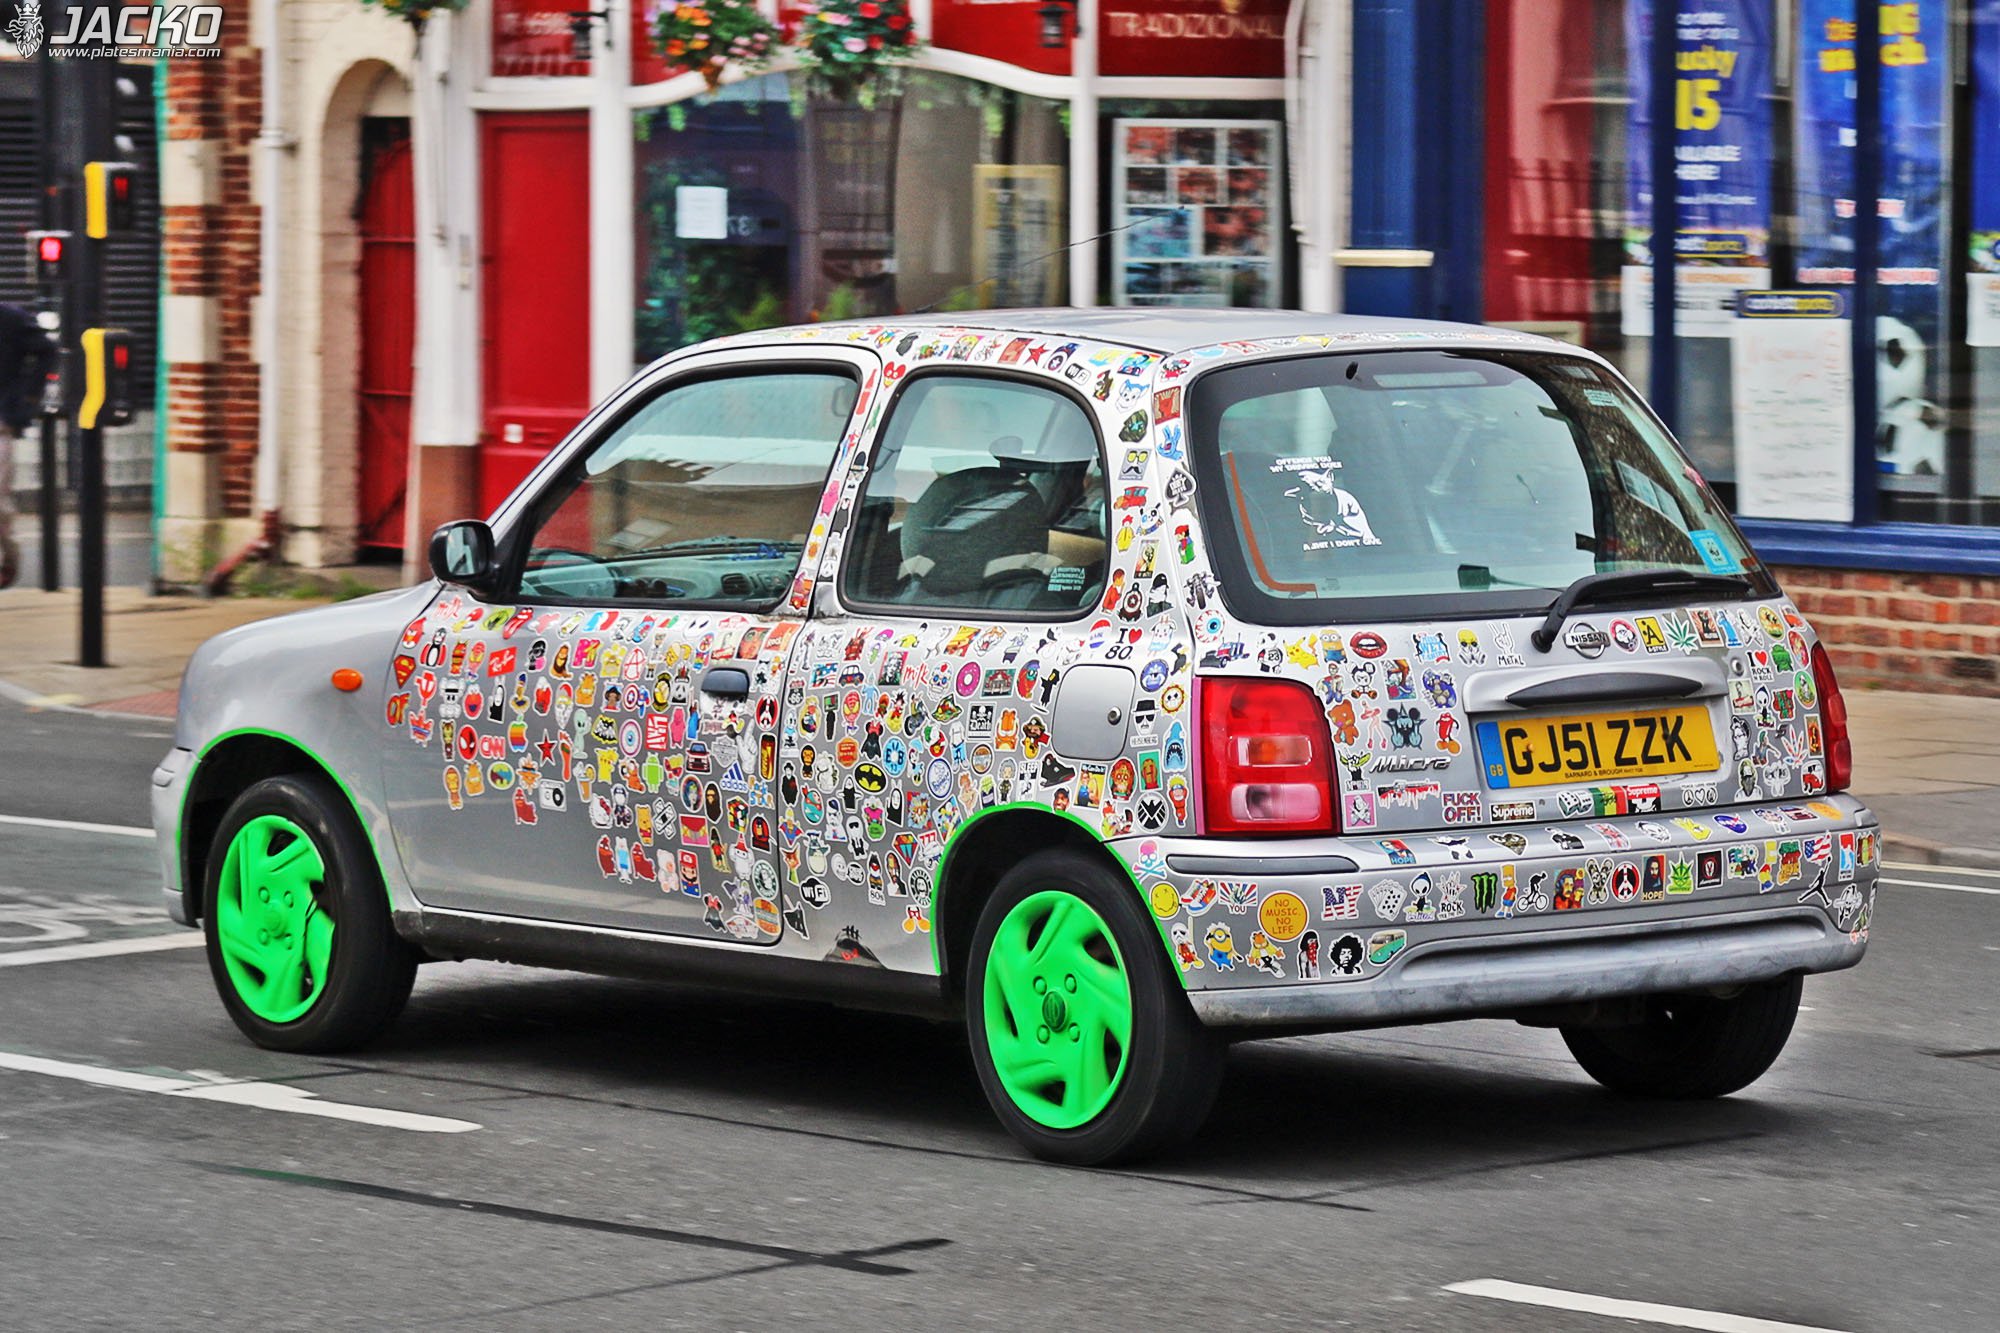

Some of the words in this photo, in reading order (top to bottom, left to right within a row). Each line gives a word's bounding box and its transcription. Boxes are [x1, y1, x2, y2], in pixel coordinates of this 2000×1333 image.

[1314, 456, 1332, 464] YOU
[1116, 629, 1128, 644] I
[1571, 631, 1607, 643] NISSAN
[1268, 651, 1280, 662] 23
[1498, 655, 1525, 666] METAL
[1747, 652, 1755, 667] I
[904, 663, 929, 690] milk
[1751, 667, 1772, 676] ROCK
[1759, 674, 1774, 682] ROLL
[481, 735, 506, 759] CNN
[1504, 722, 1601, 776] GJ51
[1606, 715, 1693, 767] ZZK
[1369, 754, 1451, 774] Micra
[1489, 763, 1504, 777] GB
[1565, 770, 1592, 779] BARNARD
[1599, 767, 1624, 776] BROUGH
[1627, 785, 1658, 797] Supreme
[1442, 792, 1481, 807] FUCK
[1442, 805, 1482, 823] OFF!
[1491, 803, 1534, 820] Supreme
[1391, 857, 1416, 865] HOPE
[1323, 885, 1363, 918] NY
[1641, 890, 1664, 901] HOPE
[1229, 905, 1247, 913] YOU
[1274, 899, 1290, 907] NO
[1441, 902, 1463, 912] ROCK
[1265, 907, 1298, 917] MUSIC
[1275, 917, 1291, 925] NO
[1271, 924, 1294, 935] LIFE
